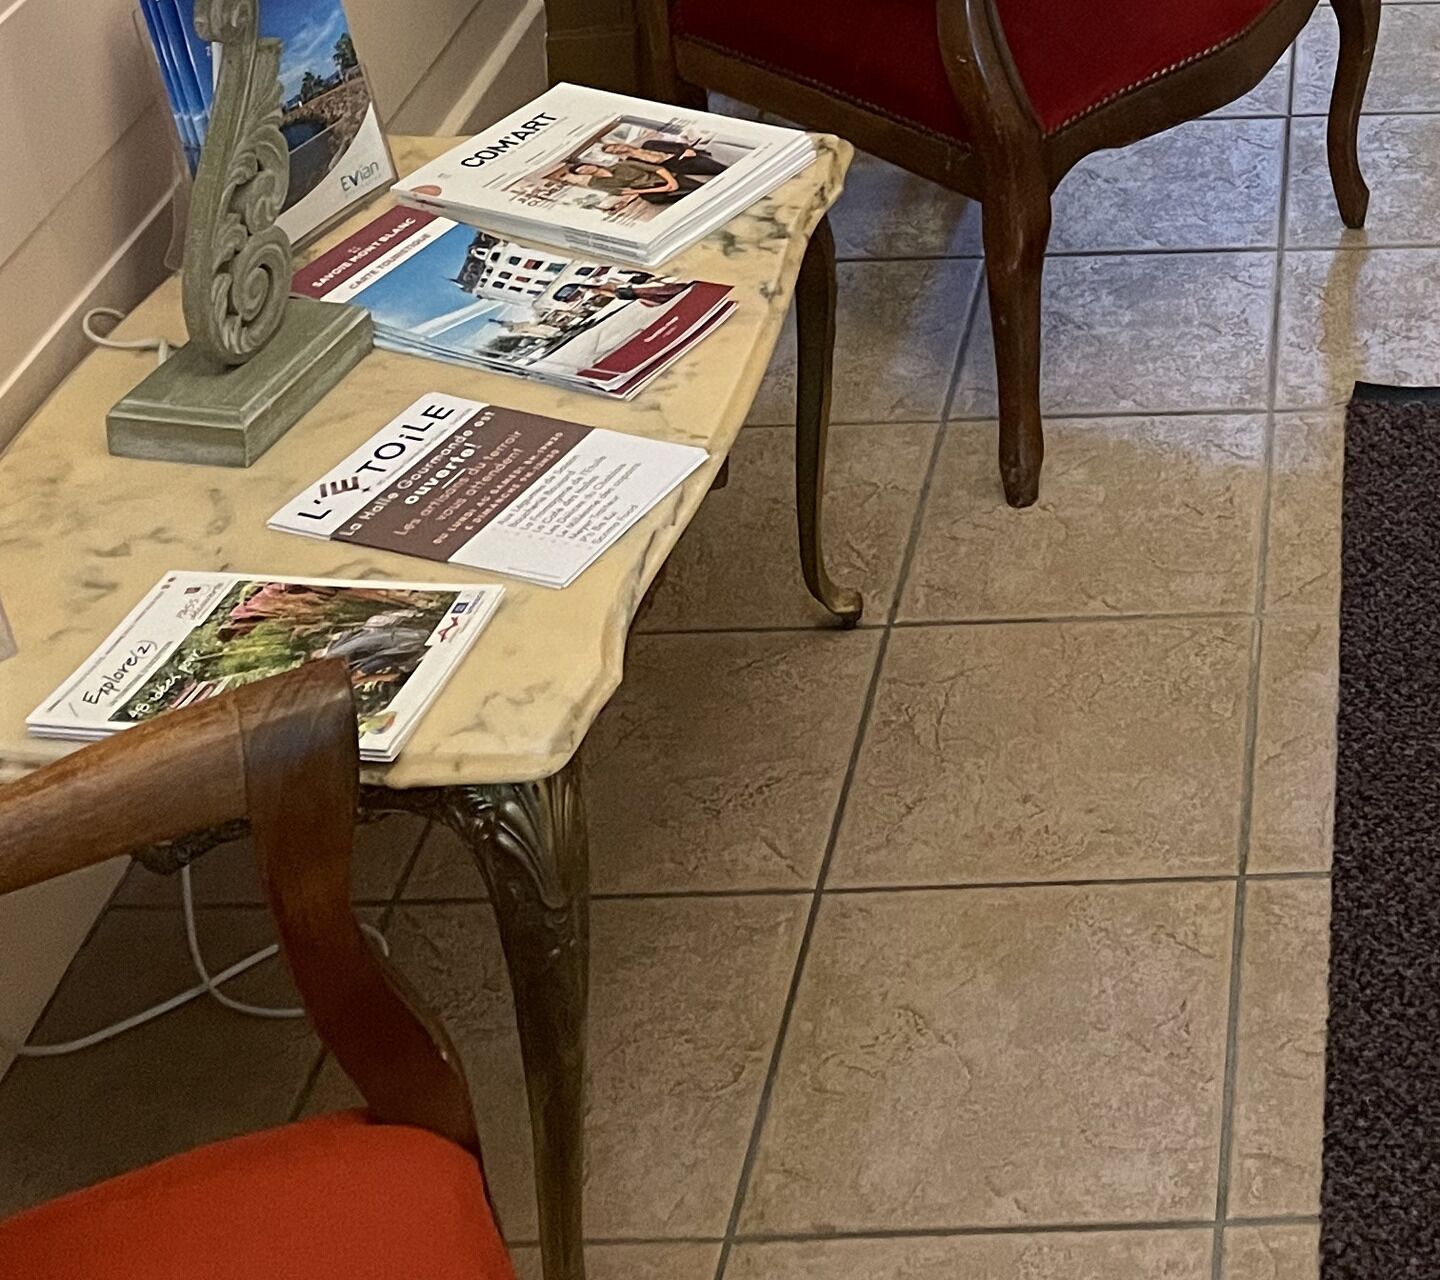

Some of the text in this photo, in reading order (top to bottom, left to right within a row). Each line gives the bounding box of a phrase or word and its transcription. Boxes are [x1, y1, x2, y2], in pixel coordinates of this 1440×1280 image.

[461, 112, 557, 168] COM'ART
[312, 218, 416, 287] SAVOIE MONT BLANC
[350, 233, 431, 289] CARTE TOURISTIQUE
[396, 429, 473, 489] Gourmande
[473, 411, 494, 427] est
[419, 477, 469, 516] artisans
[467, 462, 486, 475] du
[482, 430, 521, 460] terroir
[435, 447, 523, 520] vous attendent
[472, 483, 520, 523] DIMANCHE
[128, 702, 152, 719] 48
